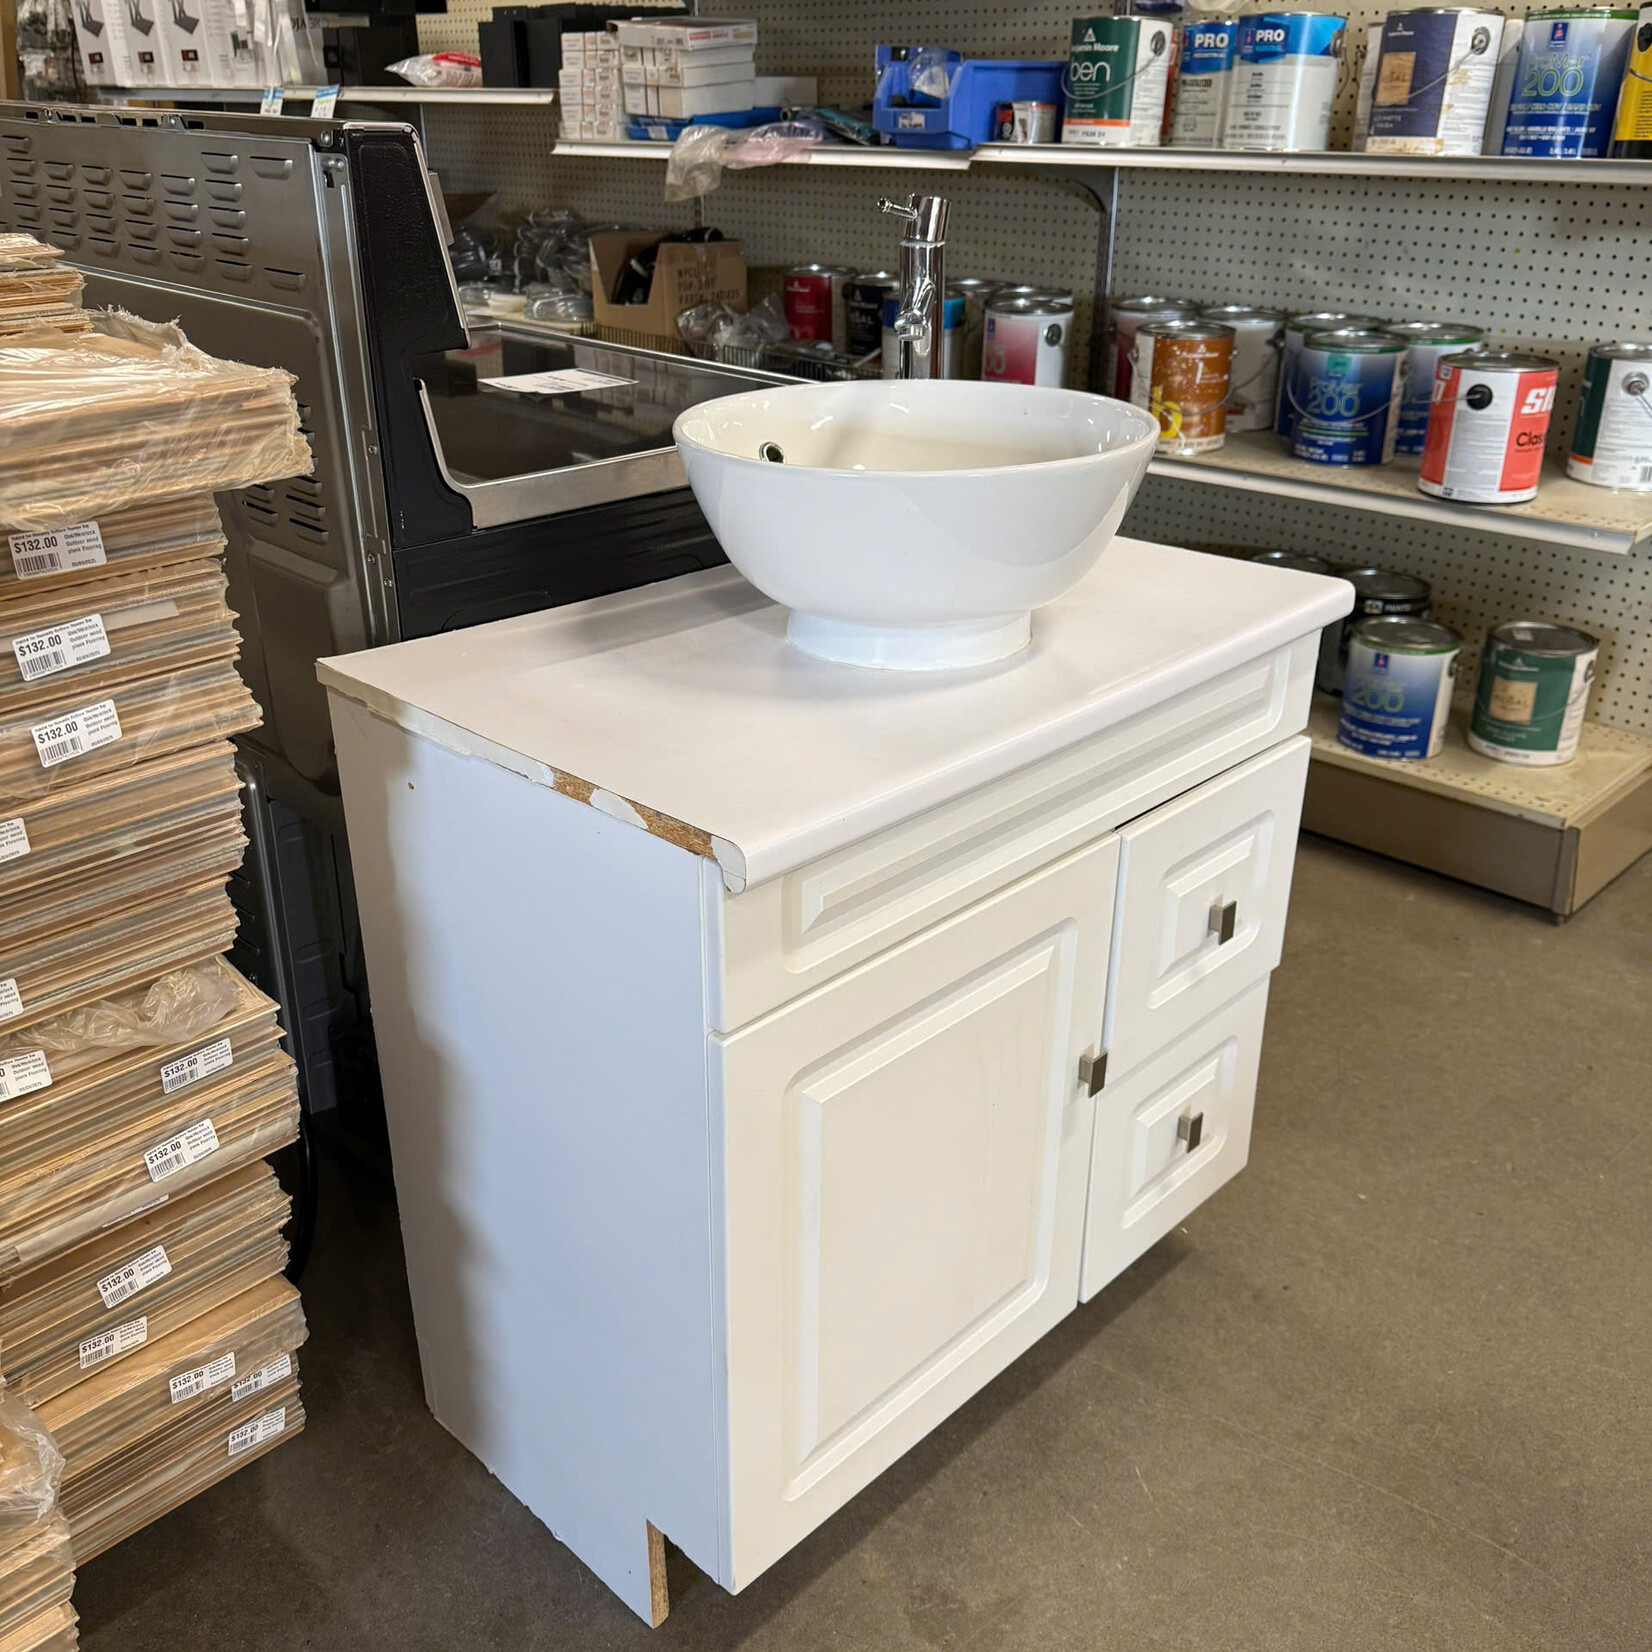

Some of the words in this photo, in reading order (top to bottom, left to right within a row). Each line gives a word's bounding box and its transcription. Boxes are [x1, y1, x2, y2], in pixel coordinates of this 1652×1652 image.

[1194, 33, 1229, 48] PRO
[1255, 29, 1285, 42] PRO
[1093, 43, 1120, 52] Moore
[1069, 57, 1110, 82] ben
[1522, 66, 1583, 97] 200
[1307, 389, 1360, 417] 200
[14, 536, 58, 554] $132.00
[86, 636, 105, 645] Flooring
[89, 628, 102, 637] wood
[18, 634, 62, 657] $132.00
[1351, 687, 1404, 713] 200
[37, 721, 78, 744] $132.00
[164, 1058, 198, 1078] $132.00
[148, 1141, 182, 1164] $132.00
[102, 1268, 135, 1292] $132.00
[82, 1334, 115, 1353] $132.00
[172, 1371, 204, 1389] $132.00
